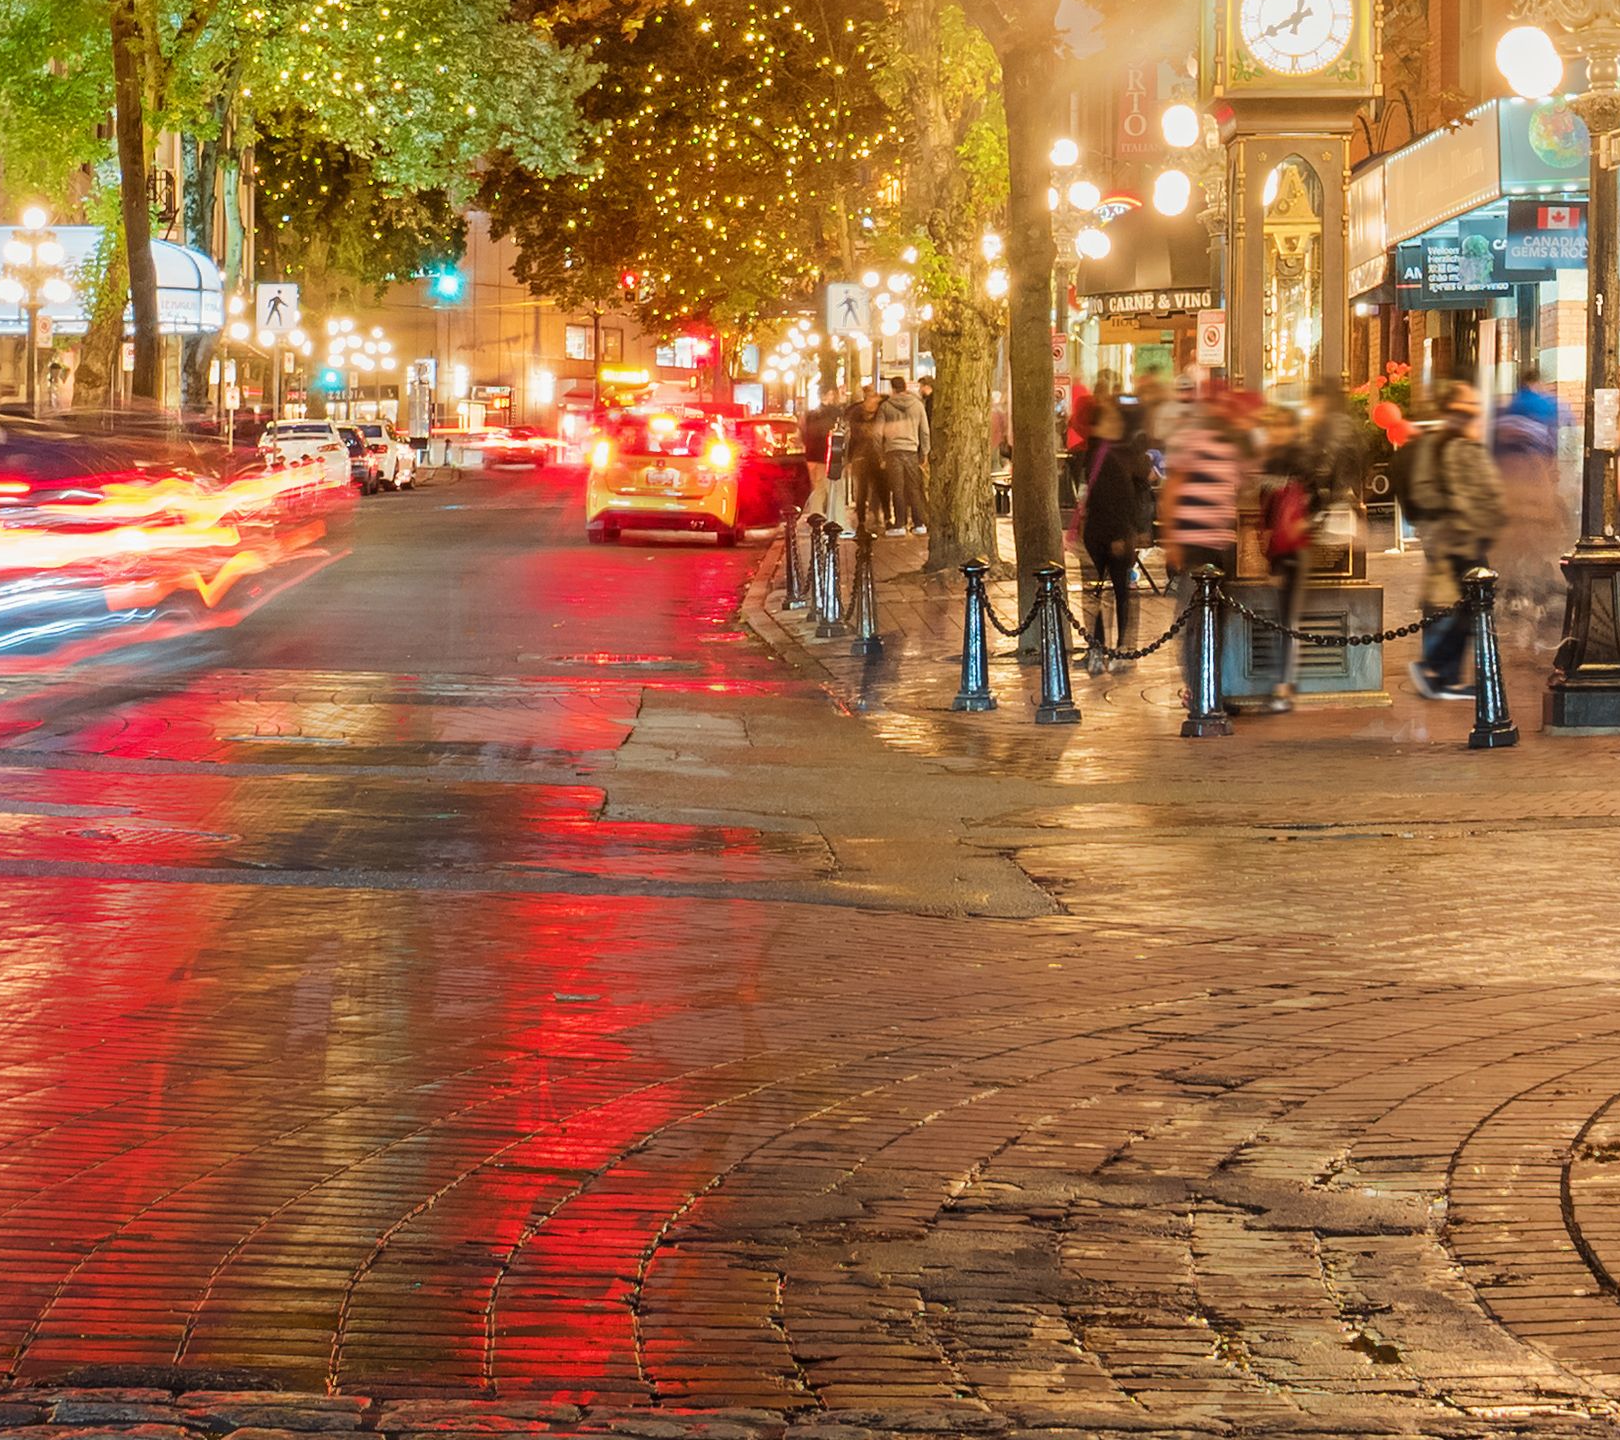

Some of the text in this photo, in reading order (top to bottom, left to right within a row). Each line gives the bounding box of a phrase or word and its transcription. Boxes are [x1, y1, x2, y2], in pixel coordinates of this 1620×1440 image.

[1511, 247, 1548, 258] GEMS
[1109, 293, 1154, 315] CARNE
[1157, 293, 1171, 310] &
[1173, 290, 1212, 309] VINO
